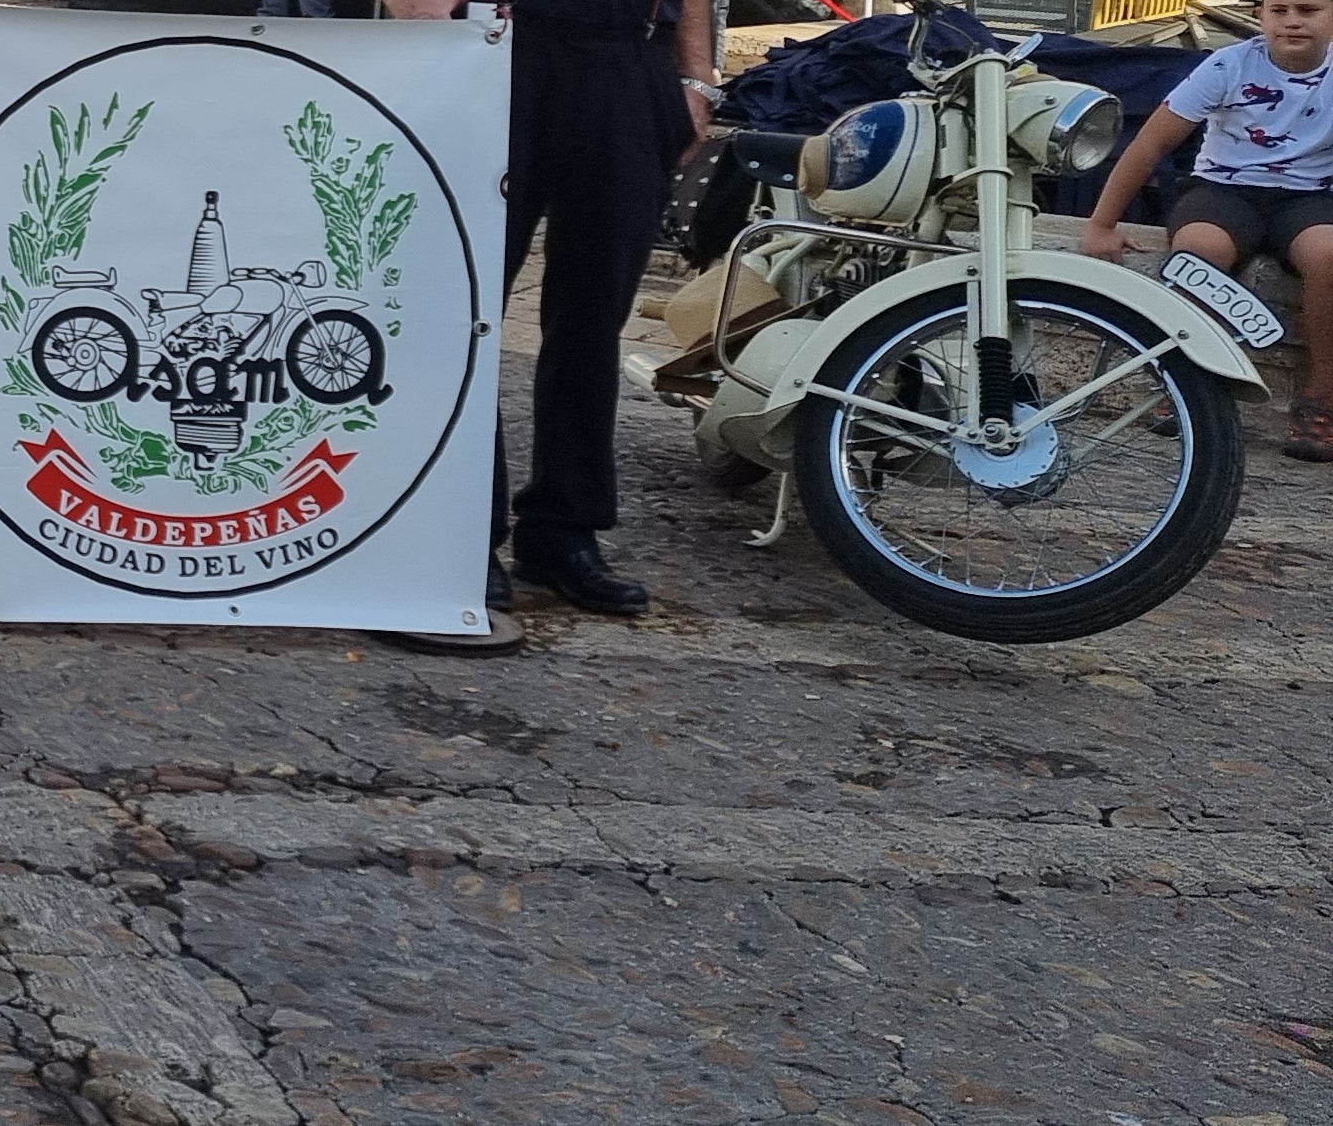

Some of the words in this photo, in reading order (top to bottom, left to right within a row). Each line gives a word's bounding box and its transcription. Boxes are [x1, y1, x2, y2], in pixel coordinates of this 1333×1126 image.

[1173, 256, 1278, 344] TO-5081
[37, 517, 167, 577] CIUDAD
[177, 553, 246, 578] DEL
[254, 527, 340, 570] VINO
[56, 491, 322, 546] VALDEPEÑAS
